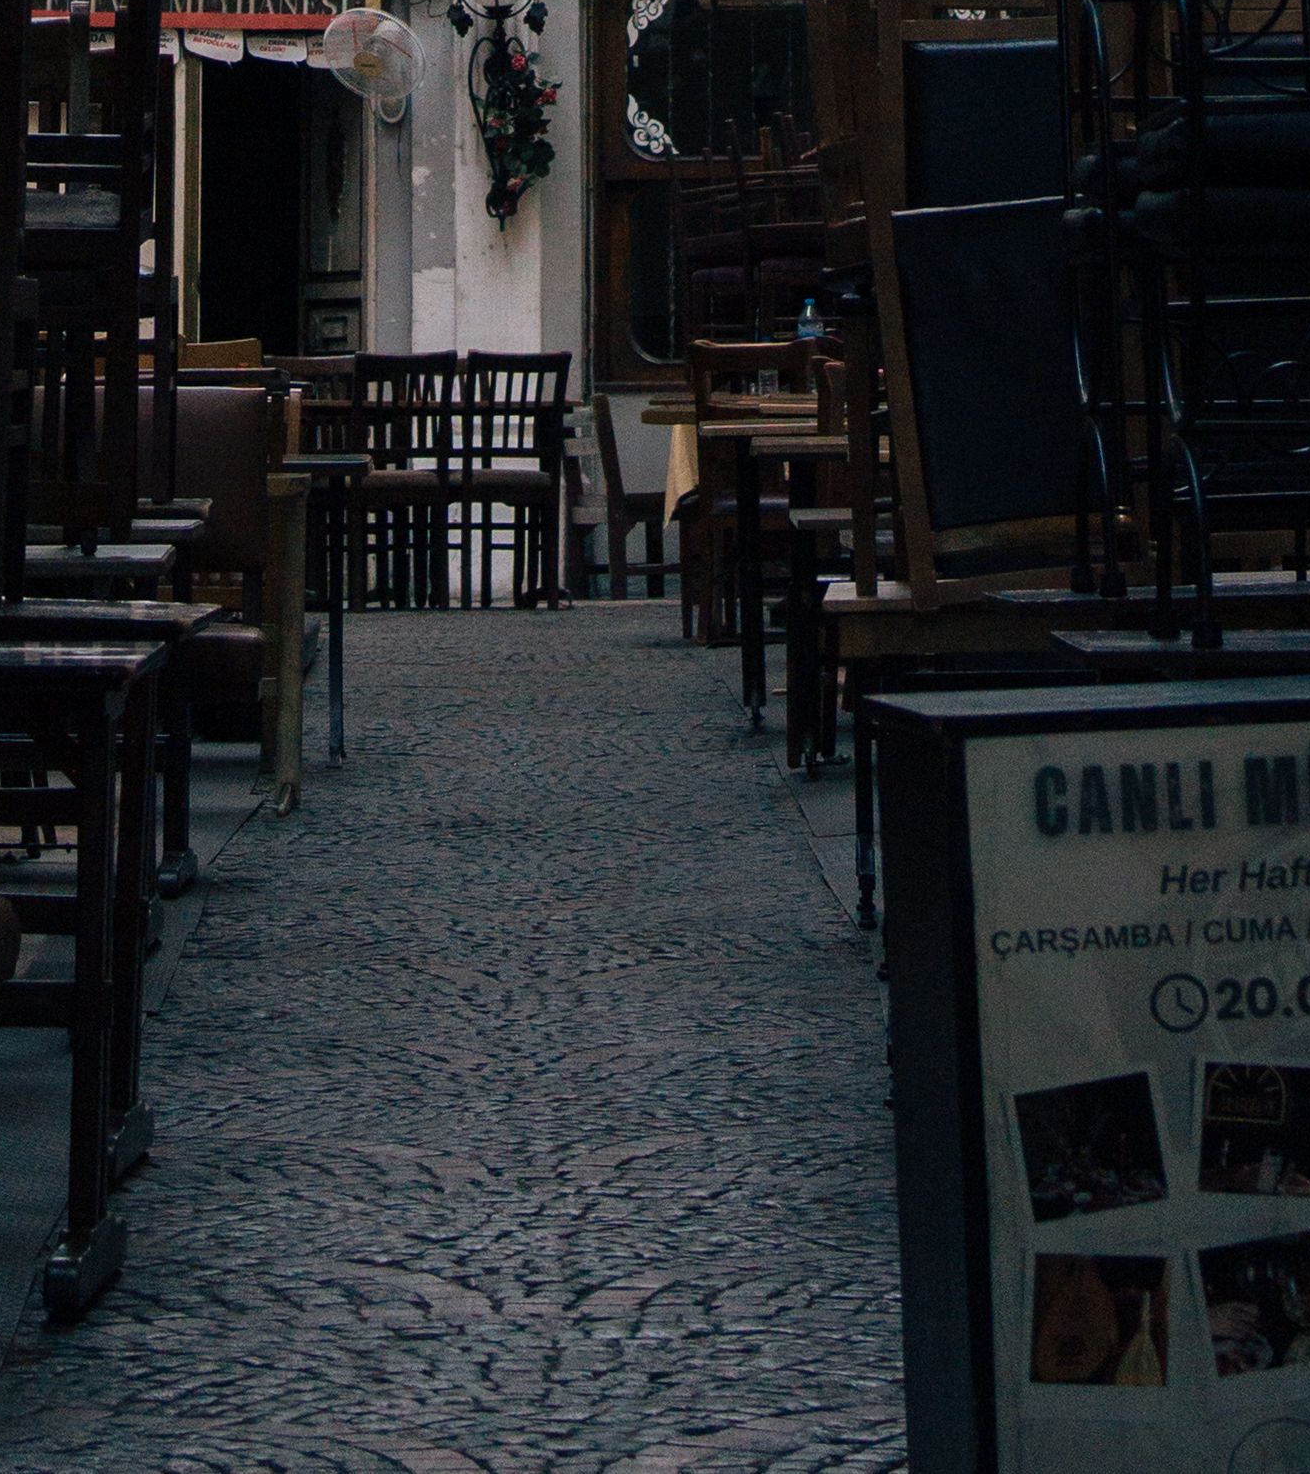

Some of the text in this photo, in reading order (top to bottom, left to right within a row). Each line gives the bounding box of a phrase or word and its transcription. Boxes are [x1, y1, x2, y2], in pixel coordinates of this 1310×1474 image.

[1033, 759, 1217, 838] CANLI
[1160, 861, 1224, 896] Her
[992, 921, 1174, 962] ÇARŞAMBA
[1203, 918, 1297, 945] CUMA
